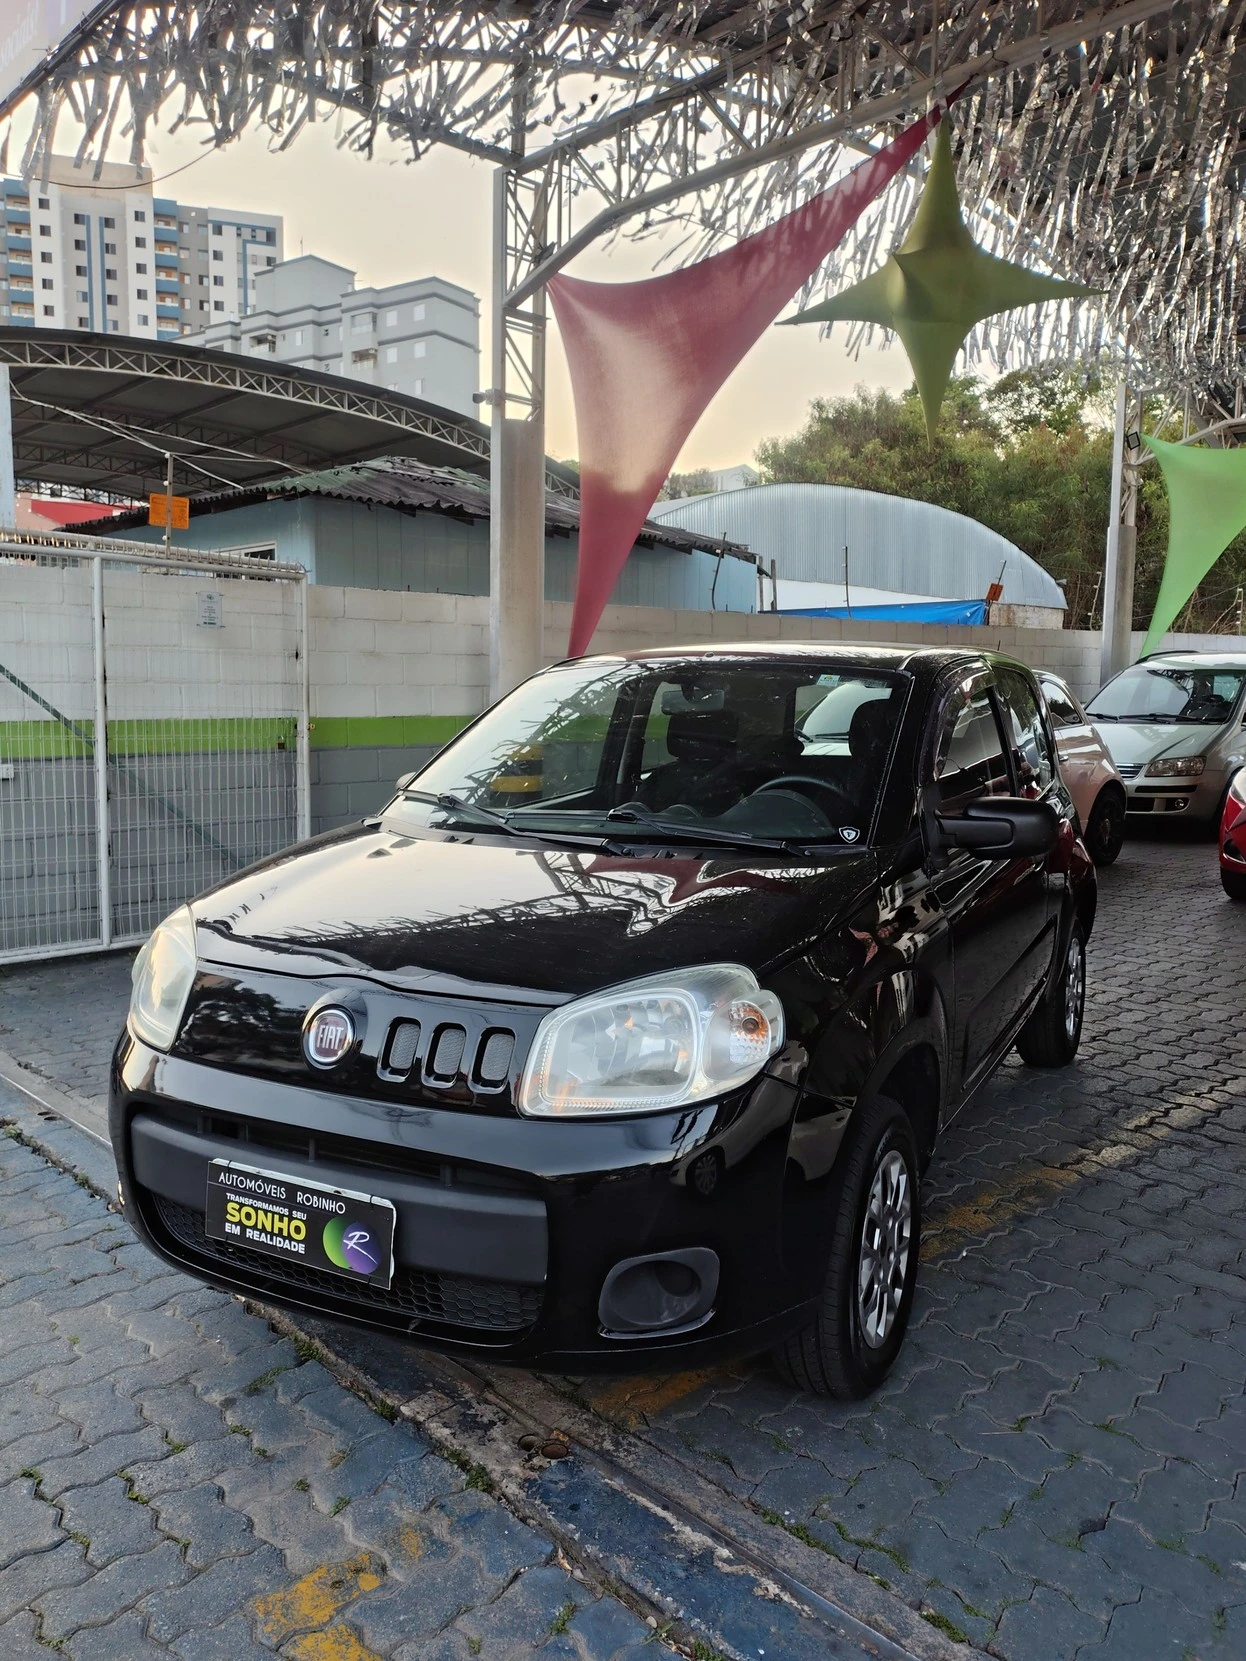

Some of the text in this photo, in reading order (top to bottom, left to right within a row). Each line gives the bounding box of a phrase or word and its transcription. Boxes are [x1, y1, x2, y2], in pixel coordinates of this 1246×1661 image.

[316, 1024, 345, 1050] FIAT
[218, 1171, 346, 1215] AUTOMÓVEIS ROBINHO
[226, 1192, 307, 1221] TRANSFORMAMOS SEU
[224, 1222, 305, 1254] EM REALIDADE
[226, 1202, 306, 1241] SONHO
[343, 1231, 378, 1265] R
